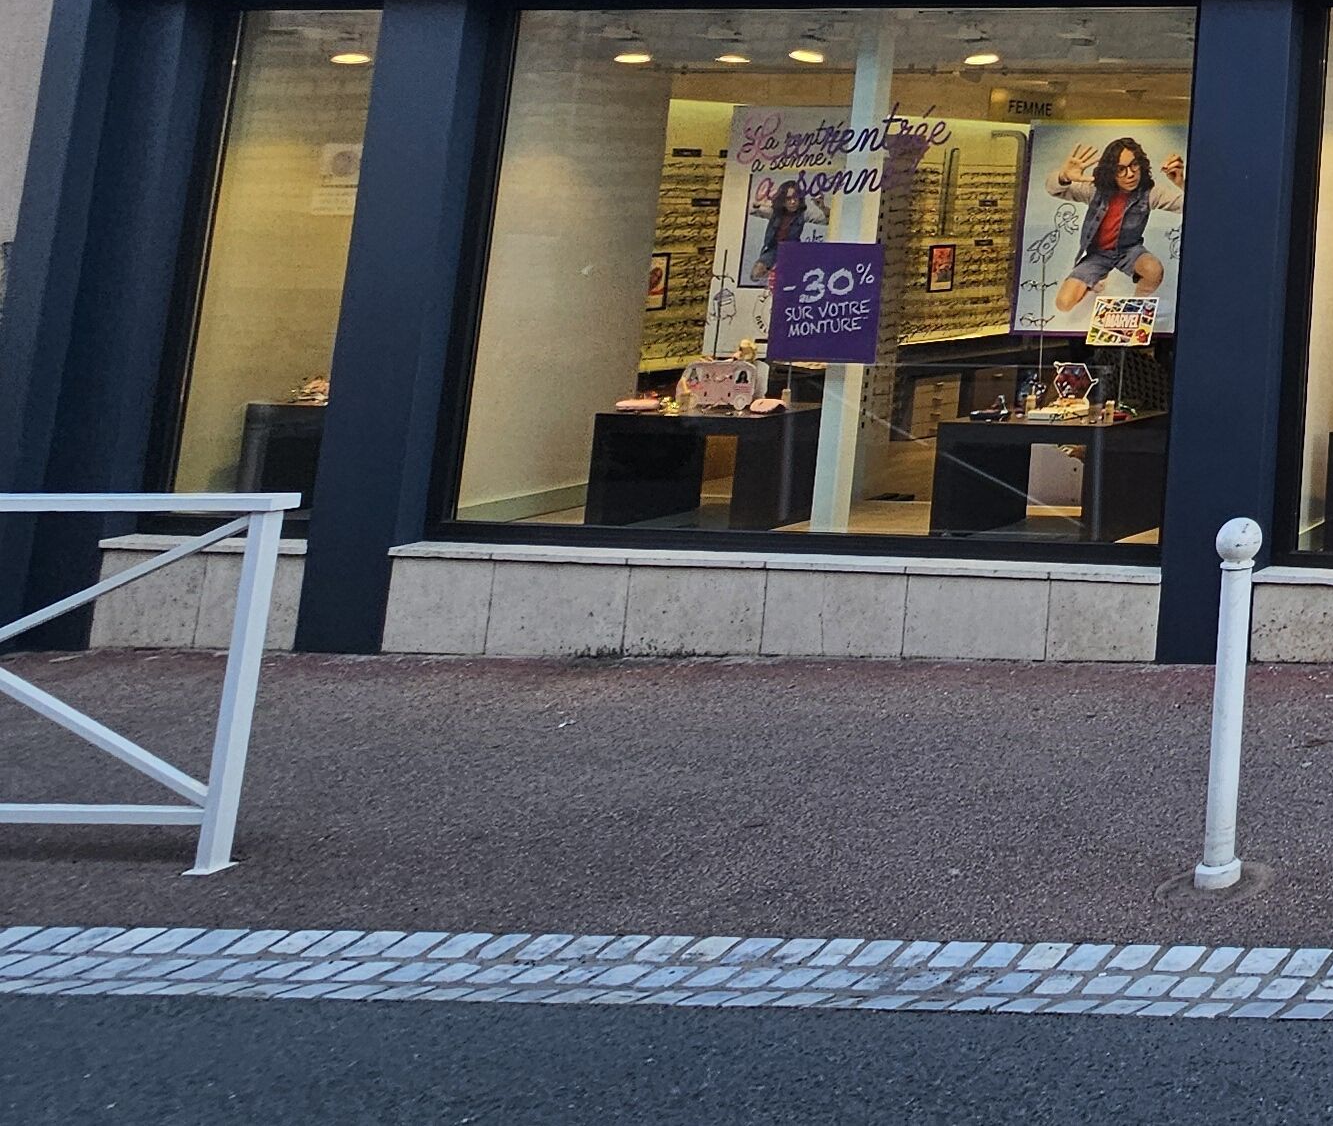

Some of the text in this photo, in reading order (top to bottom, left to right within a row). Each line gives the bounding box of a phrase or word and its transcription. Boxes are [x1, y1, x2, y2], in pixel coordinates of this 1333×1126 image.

[1007, 100, 1053, 117] FEMME
[783, 262, 875, 304] -30%
[784, 298, 871, 322] SUR VOTRE
[1104, 313, 1138, 328] MARVEL
[787, 315, 862, 338] MONTURE
